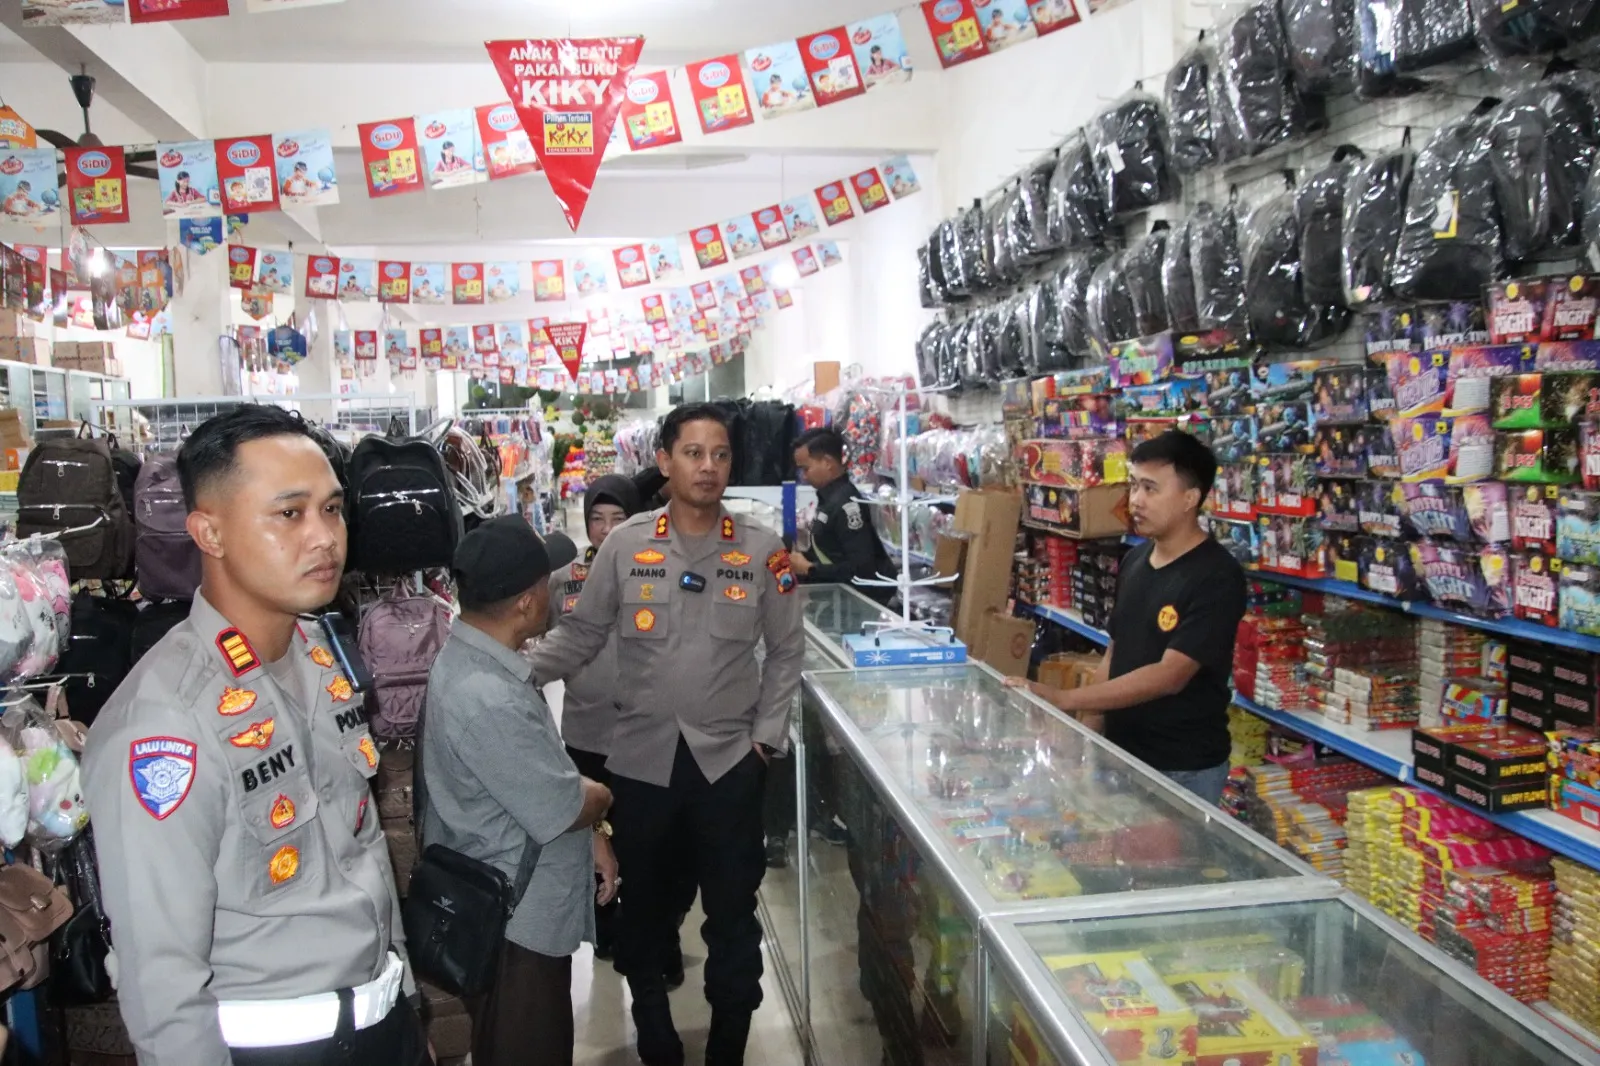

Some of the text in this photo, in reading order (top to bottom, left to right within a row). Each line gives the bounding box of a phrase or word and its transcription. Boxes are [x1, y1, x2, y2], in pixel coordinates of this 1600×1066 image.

[509, 46, 622, 60] ANAK KREATIF
[514, 63, 618, 77] PAKAI BUKU
[521, 79, 611, 105] KIKY
[492, 113, 516, 125] SiDU
[375, 130, 401, 142] SiDU
[231, 148, 258, 159] SiDU
[81, 160, 108, 169] SiDU
[1515, 516, 1552, 539] NIGHT
[630, 568, 666, 578] ANANG
[717, 568, 754, 581] POLRI
[1516, 585, 1555, 611] NIGHT
[335, 704, 367, 733] POL
[135, 740, 193, 756] LALU LINTAS
[241, 745, 296, 793] BENY
